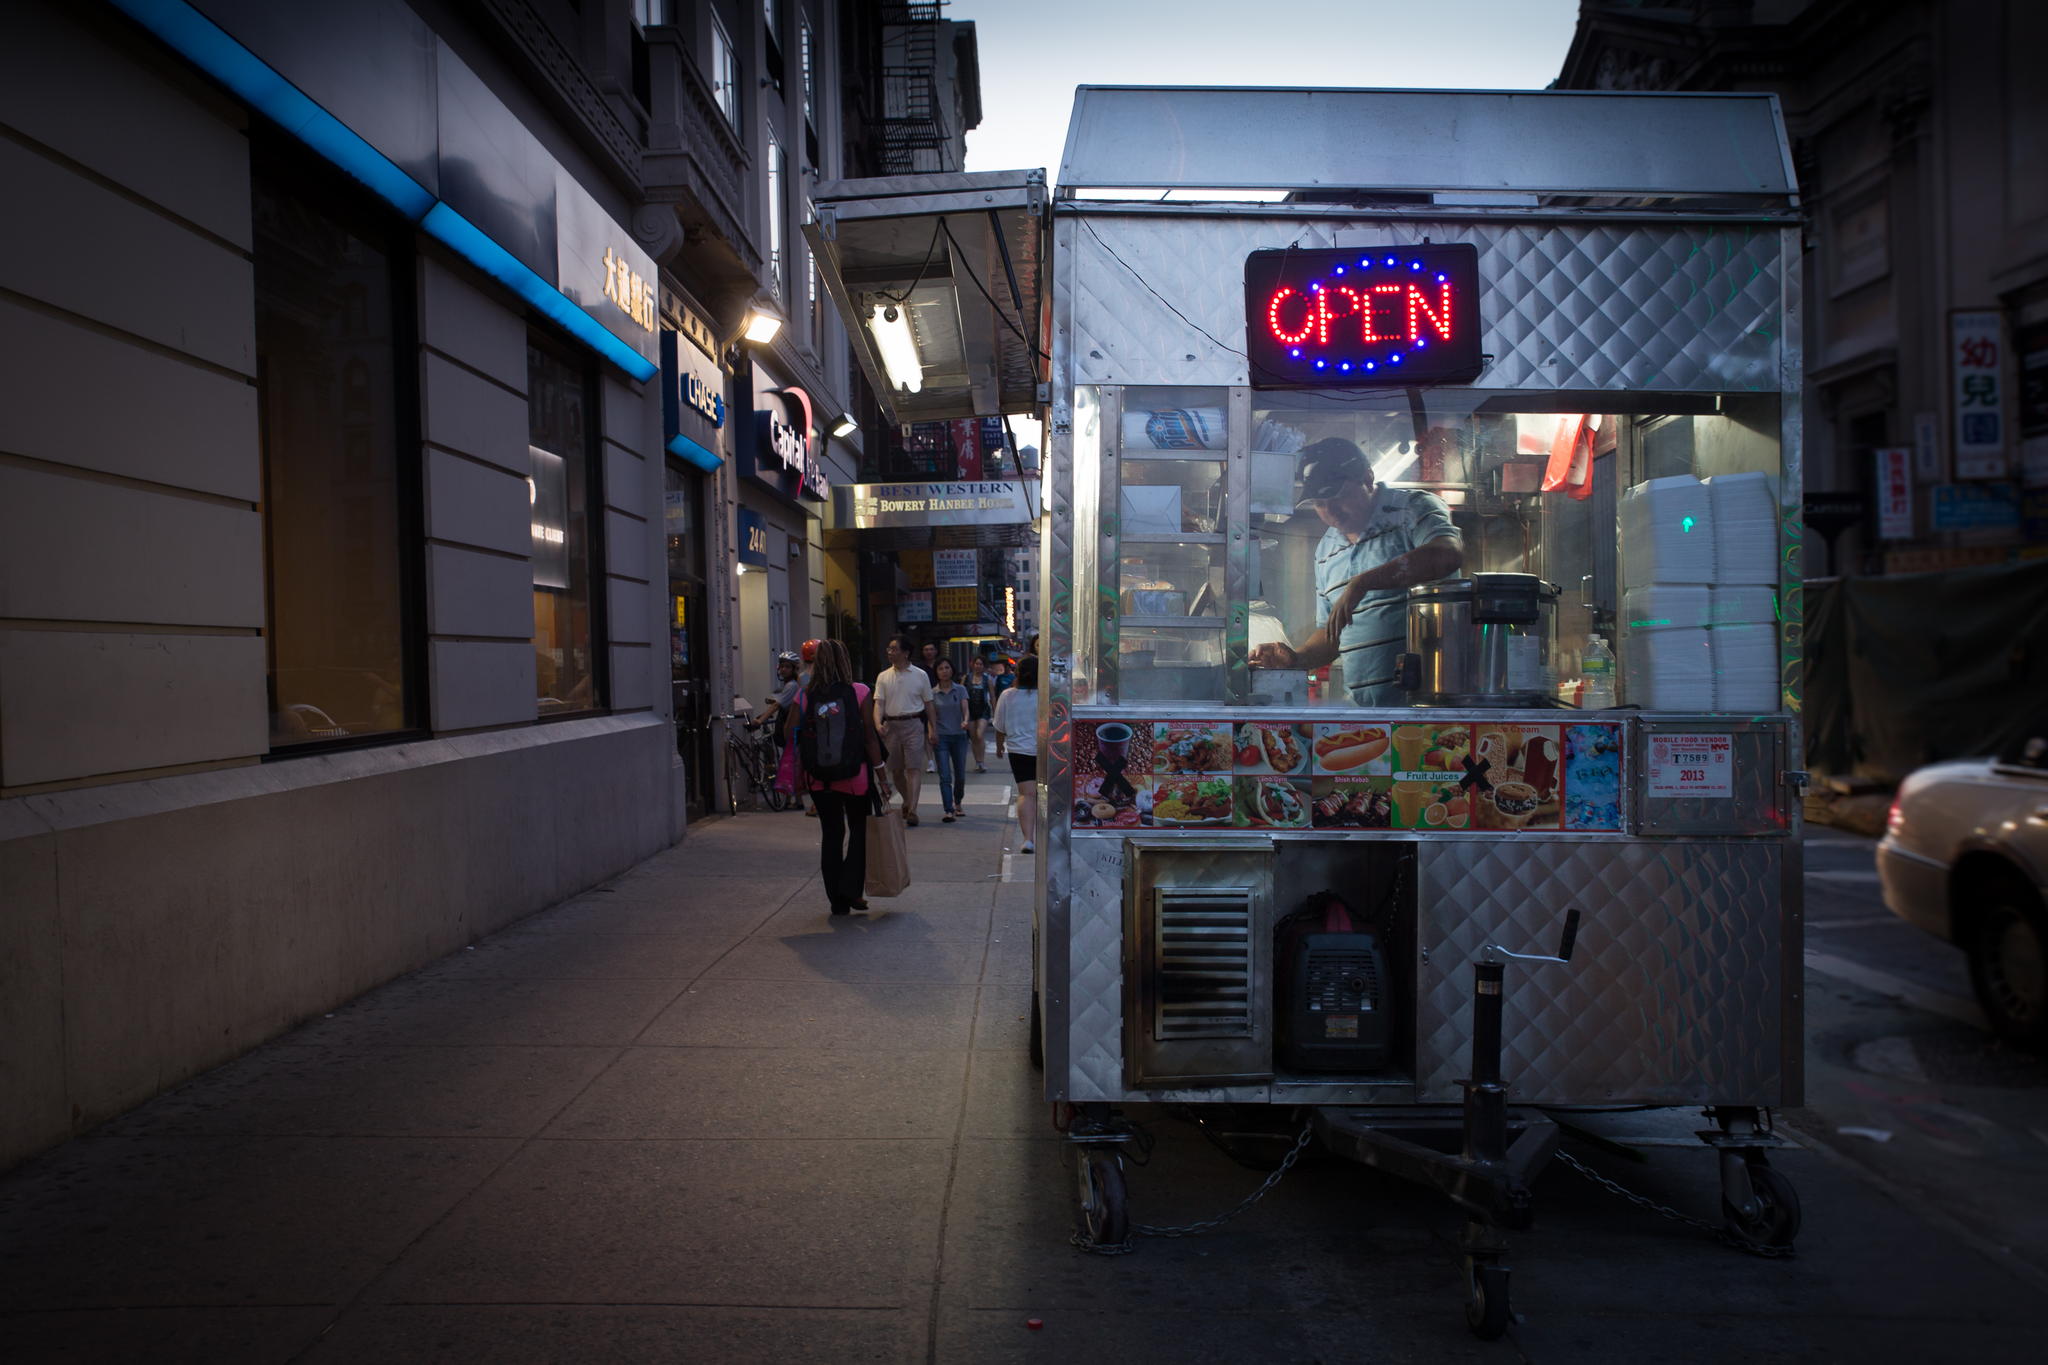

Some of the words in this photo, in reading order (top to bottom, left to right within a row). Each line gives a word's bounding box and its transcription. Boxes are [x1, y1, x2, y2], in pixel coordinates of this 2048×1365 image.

[1269, 284, 1450, 344] OPEN
[686, 371, 718, 423] CHASE
[769, 408, 804, 475] Capital
[880, 485, 922, 497] BEST
[928, 482, 1014, 495] WESTERN
[880, 499, 926, 512] BOWERY
[749, 525, 759, 552] 24
[1406, 772, 1427, 780] Fruit
[1430, 772, 1459, 780] Juices
[1680, 769, 1704, 781] 2013
